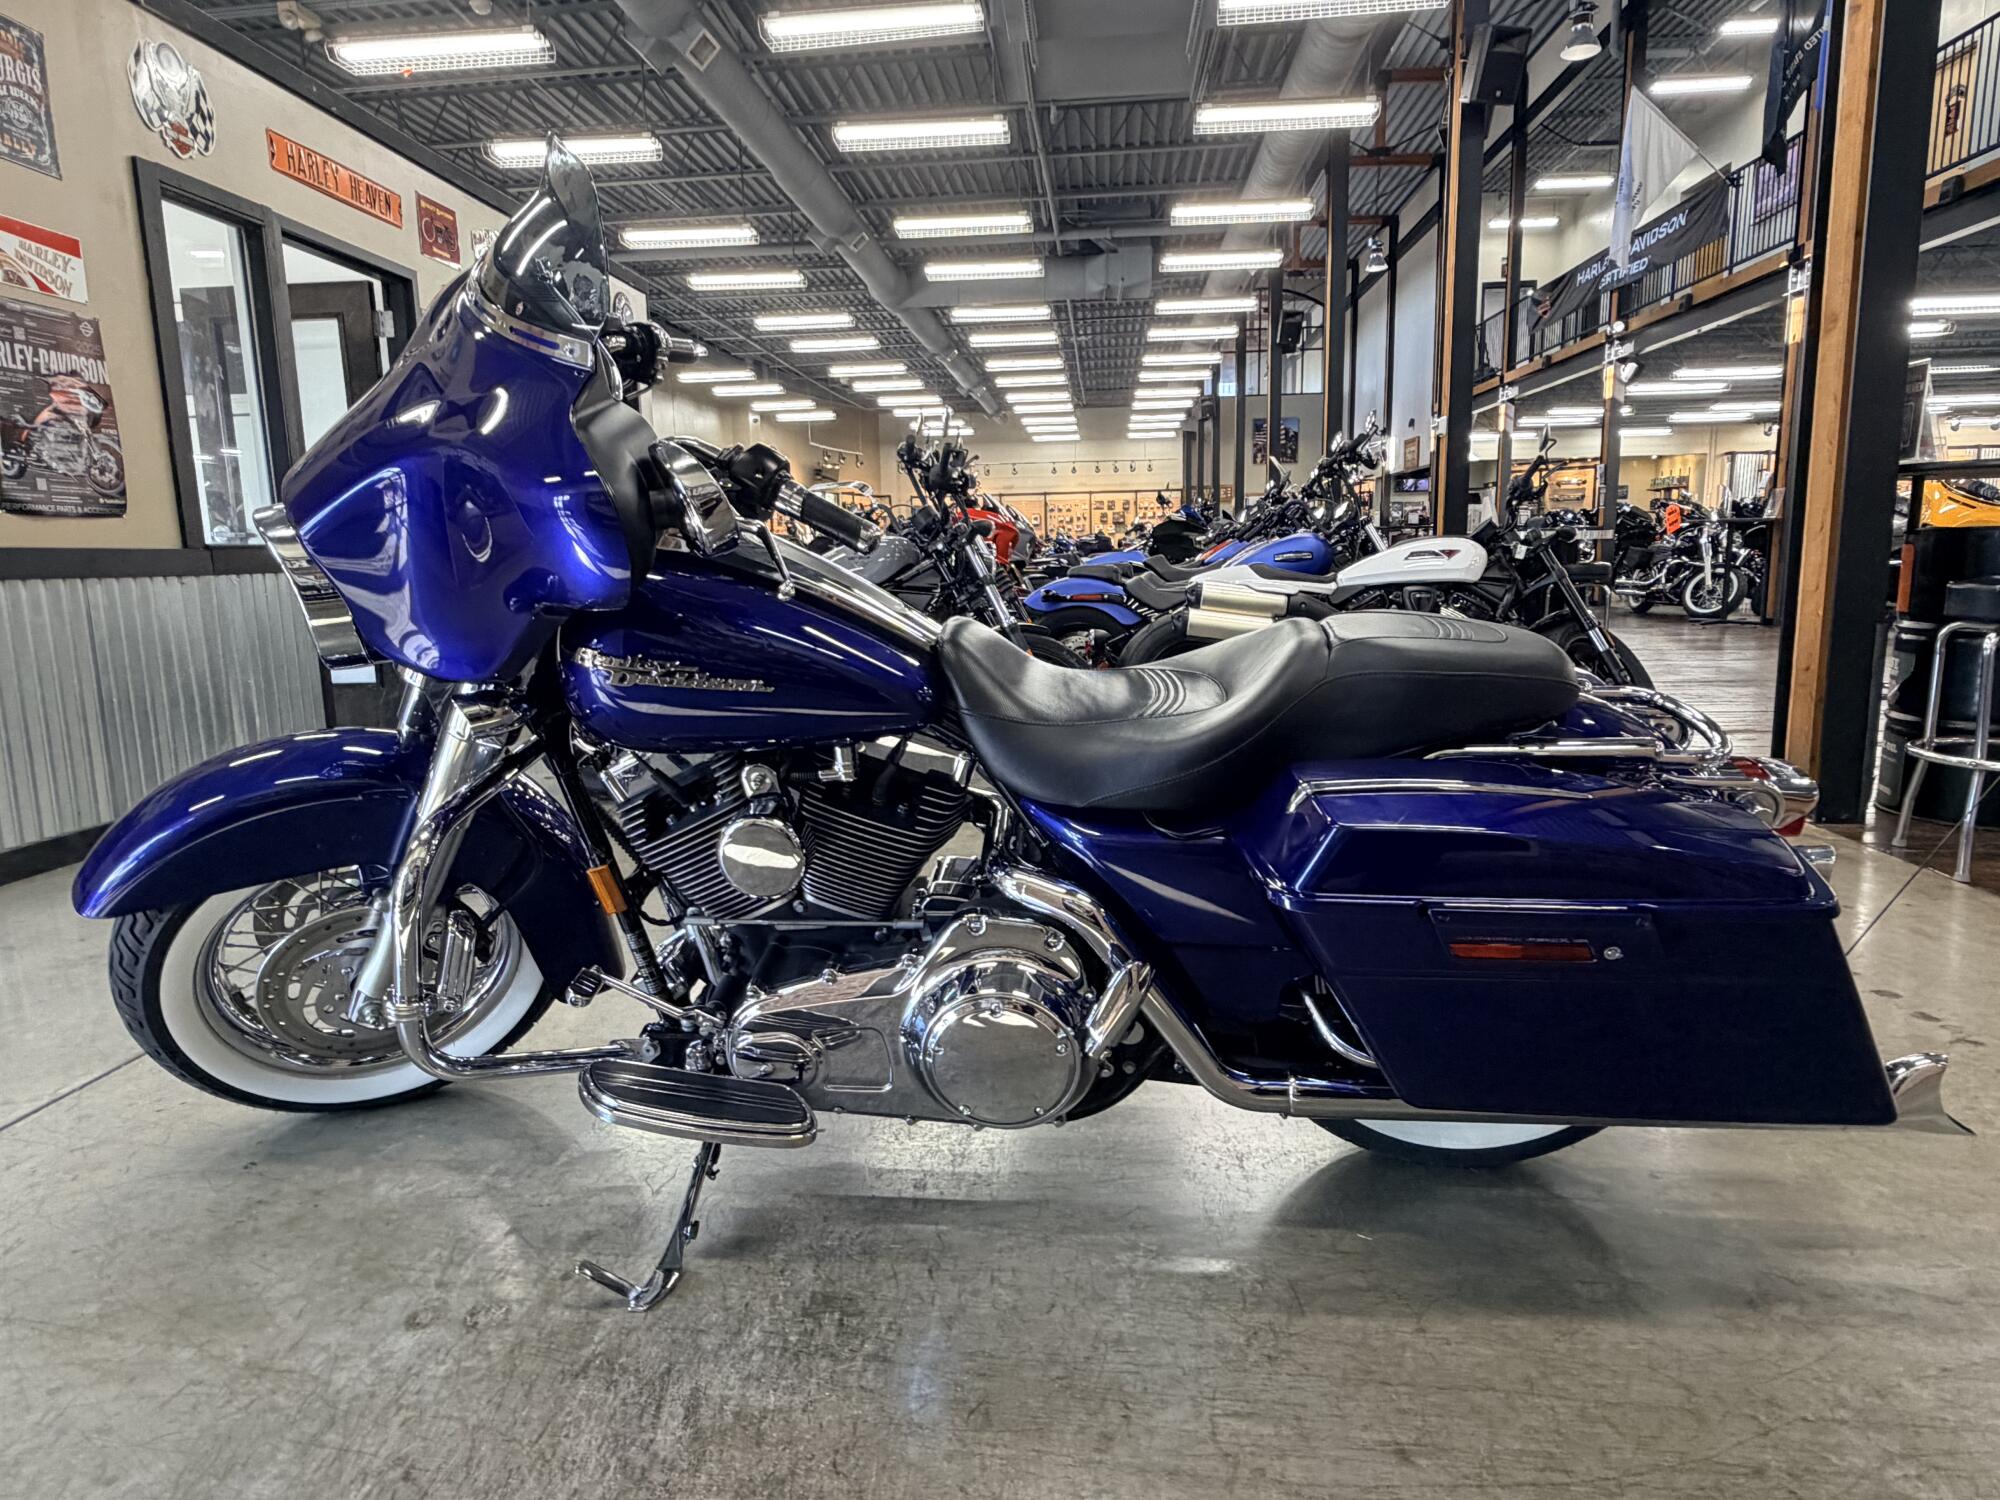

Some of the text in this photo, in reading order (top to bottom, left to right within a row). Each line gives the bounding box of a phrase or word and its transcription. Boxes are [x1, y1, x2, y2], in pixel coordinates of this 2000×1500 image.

[286, 142, 339, 192] HARLEY
[349, 173, 391, 218] HEAVEN
[15, 248, 73, 298] DAVIDSON
[18, 240, 77, 273] HARLEY-
